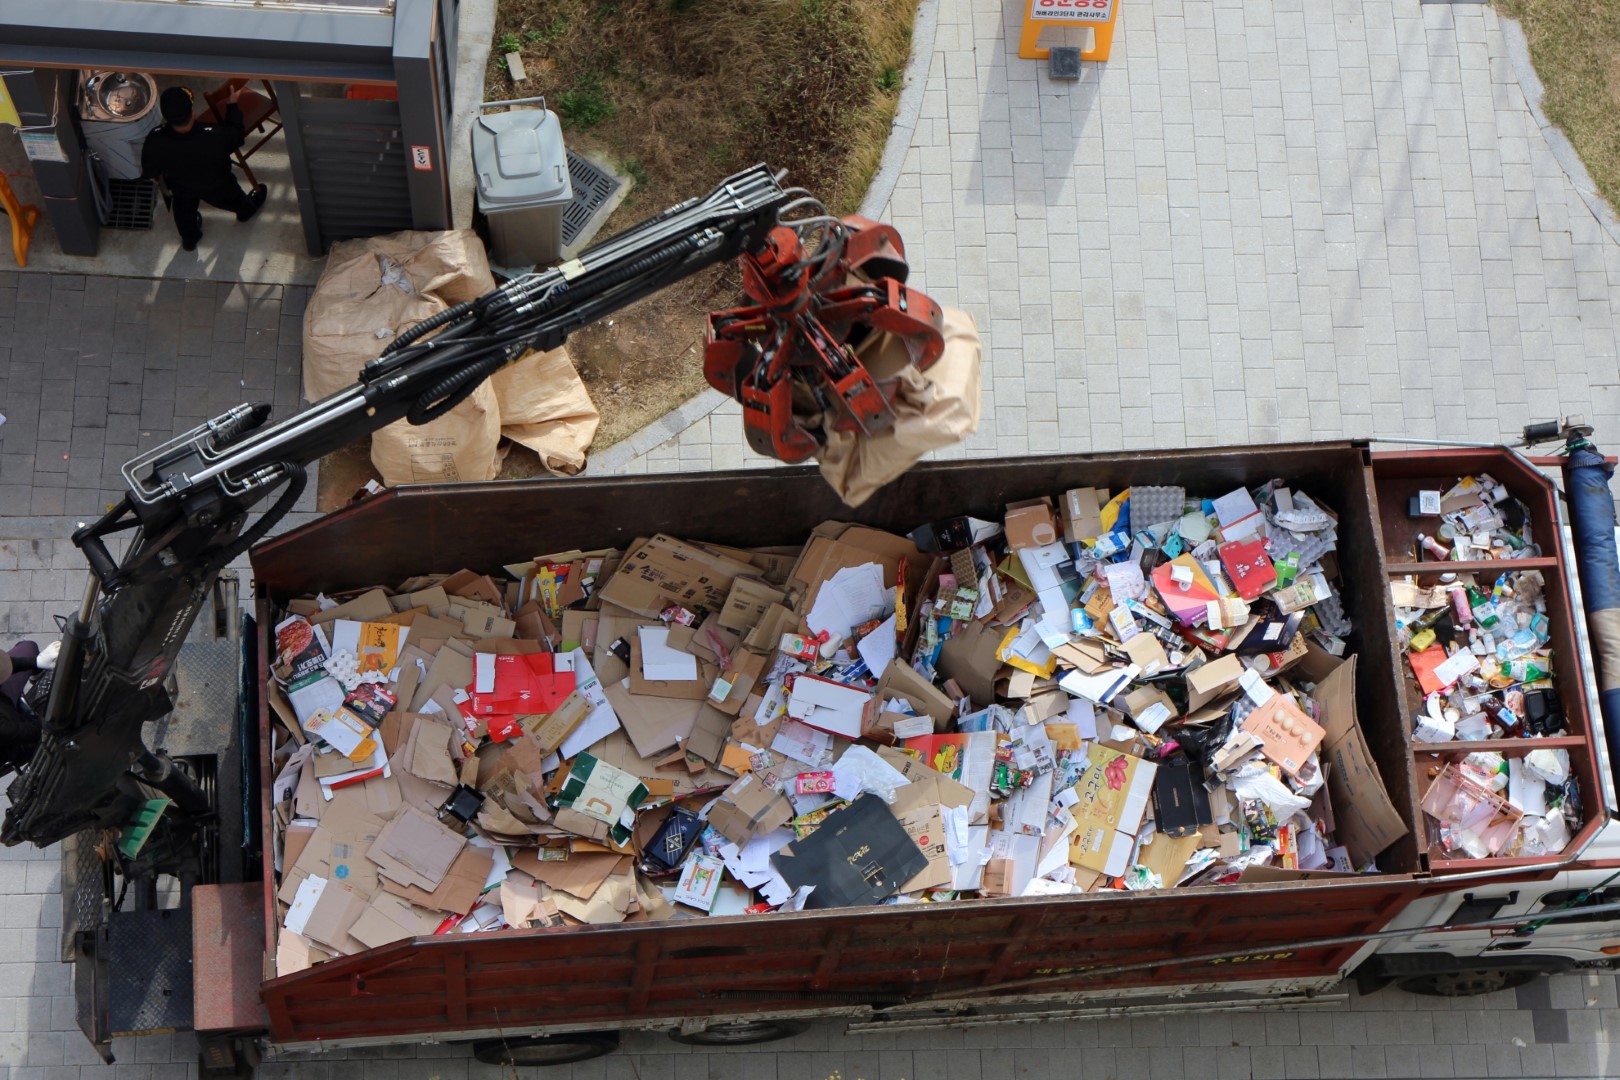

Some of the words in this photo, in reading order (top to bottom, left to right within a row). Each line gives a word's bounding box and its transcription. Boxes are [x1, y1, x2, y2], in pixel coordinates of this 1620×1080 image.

[416, 148, 426, 165] CCTV
[1084, 763, 1103, 804] 고구마
[1080, 825, 1093, 853] 고구마
